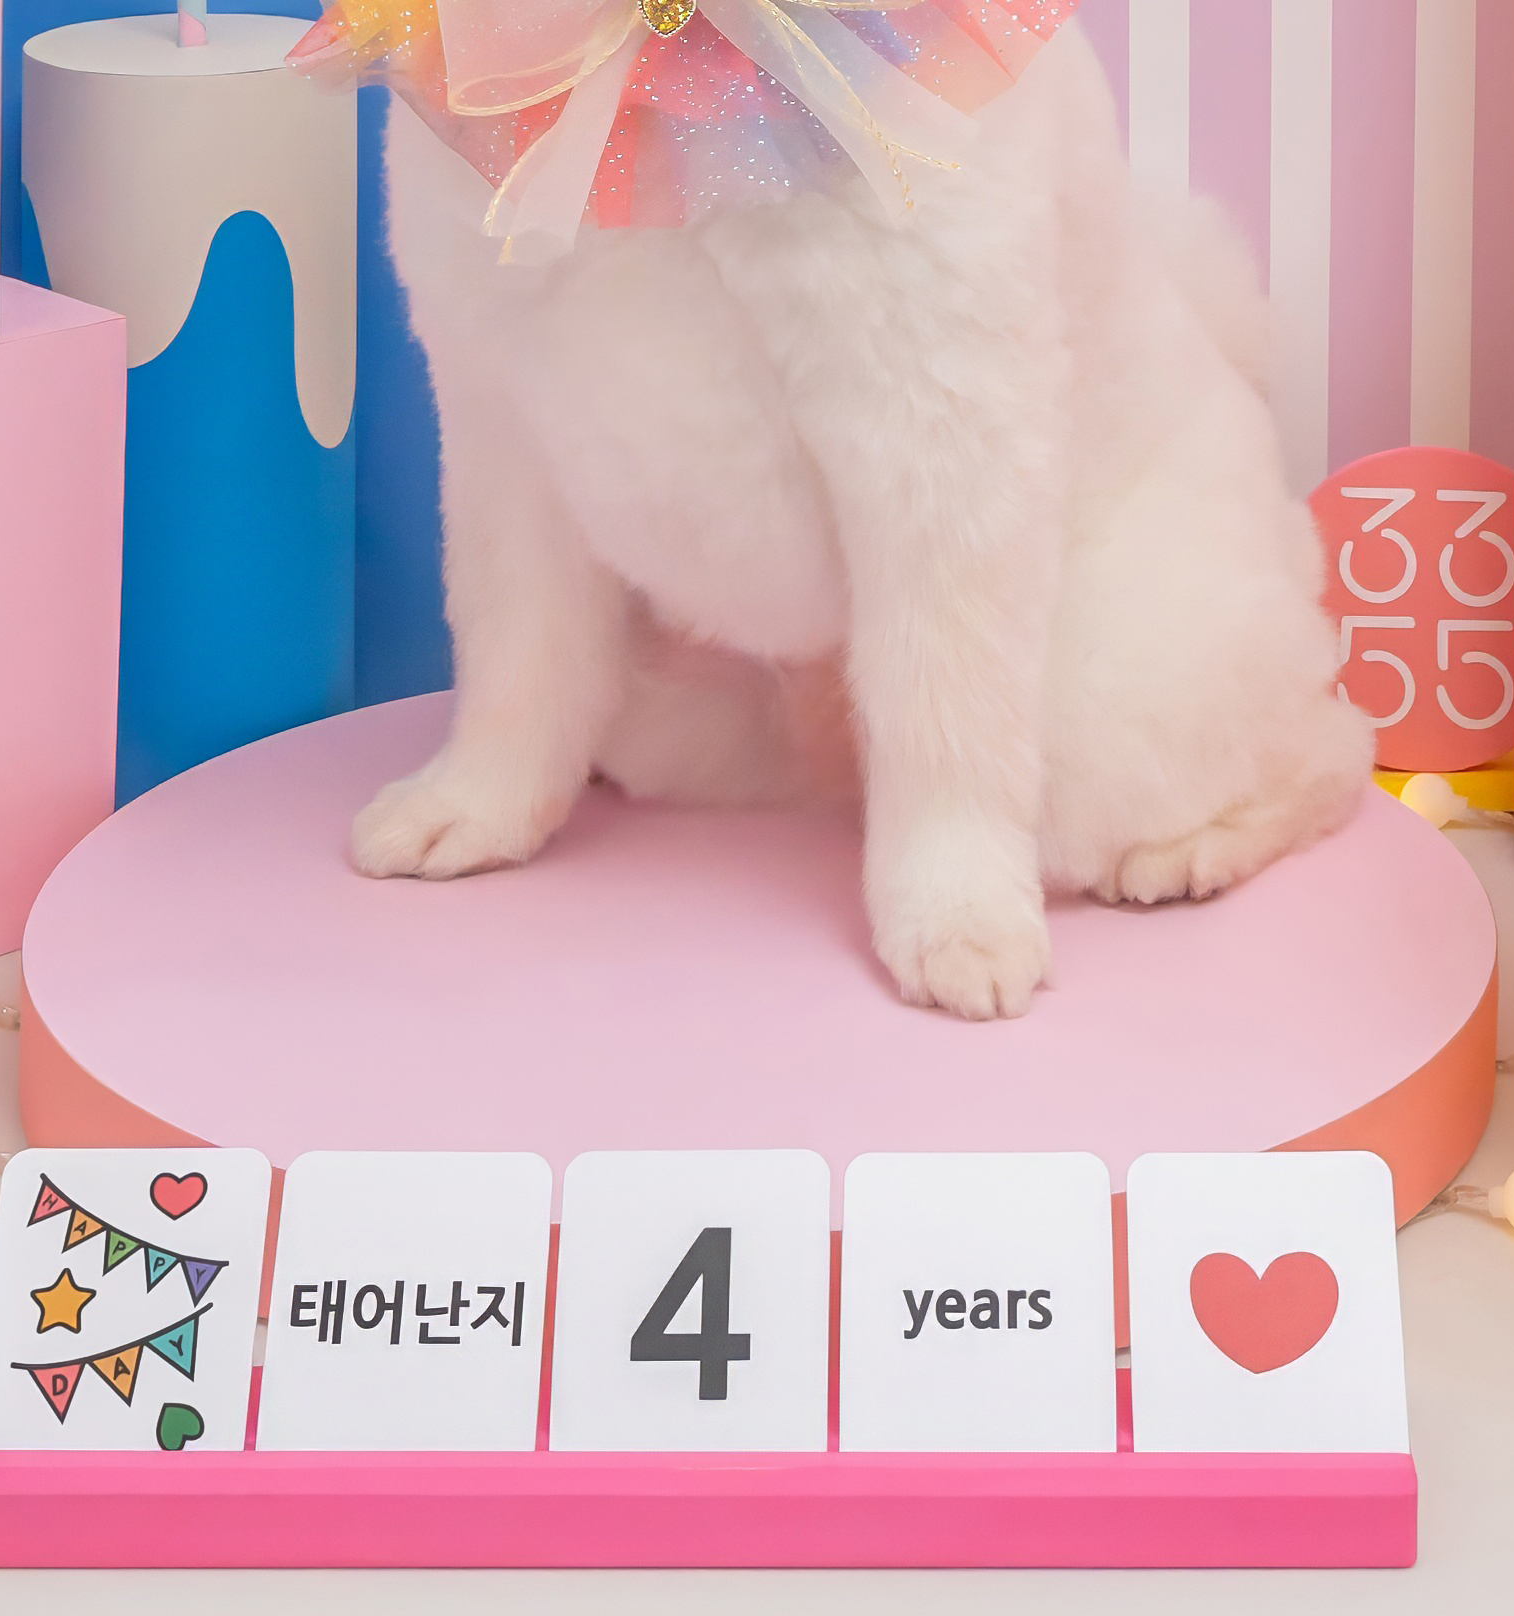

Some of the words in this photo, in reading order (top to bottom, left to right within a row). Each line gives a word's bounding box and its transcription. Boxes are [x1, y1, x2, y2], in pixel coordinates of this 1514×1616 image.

[1337, 615, 1514, 730] 55
[42, 1193, 208, 1284] HAPPY
[51, 1334, 185, 1397] DAY
[290, 1279, 525, 1347] 태어난지
[629, 1227, 751, 1401] 4
[902, 1288, 1053, 1340] years
